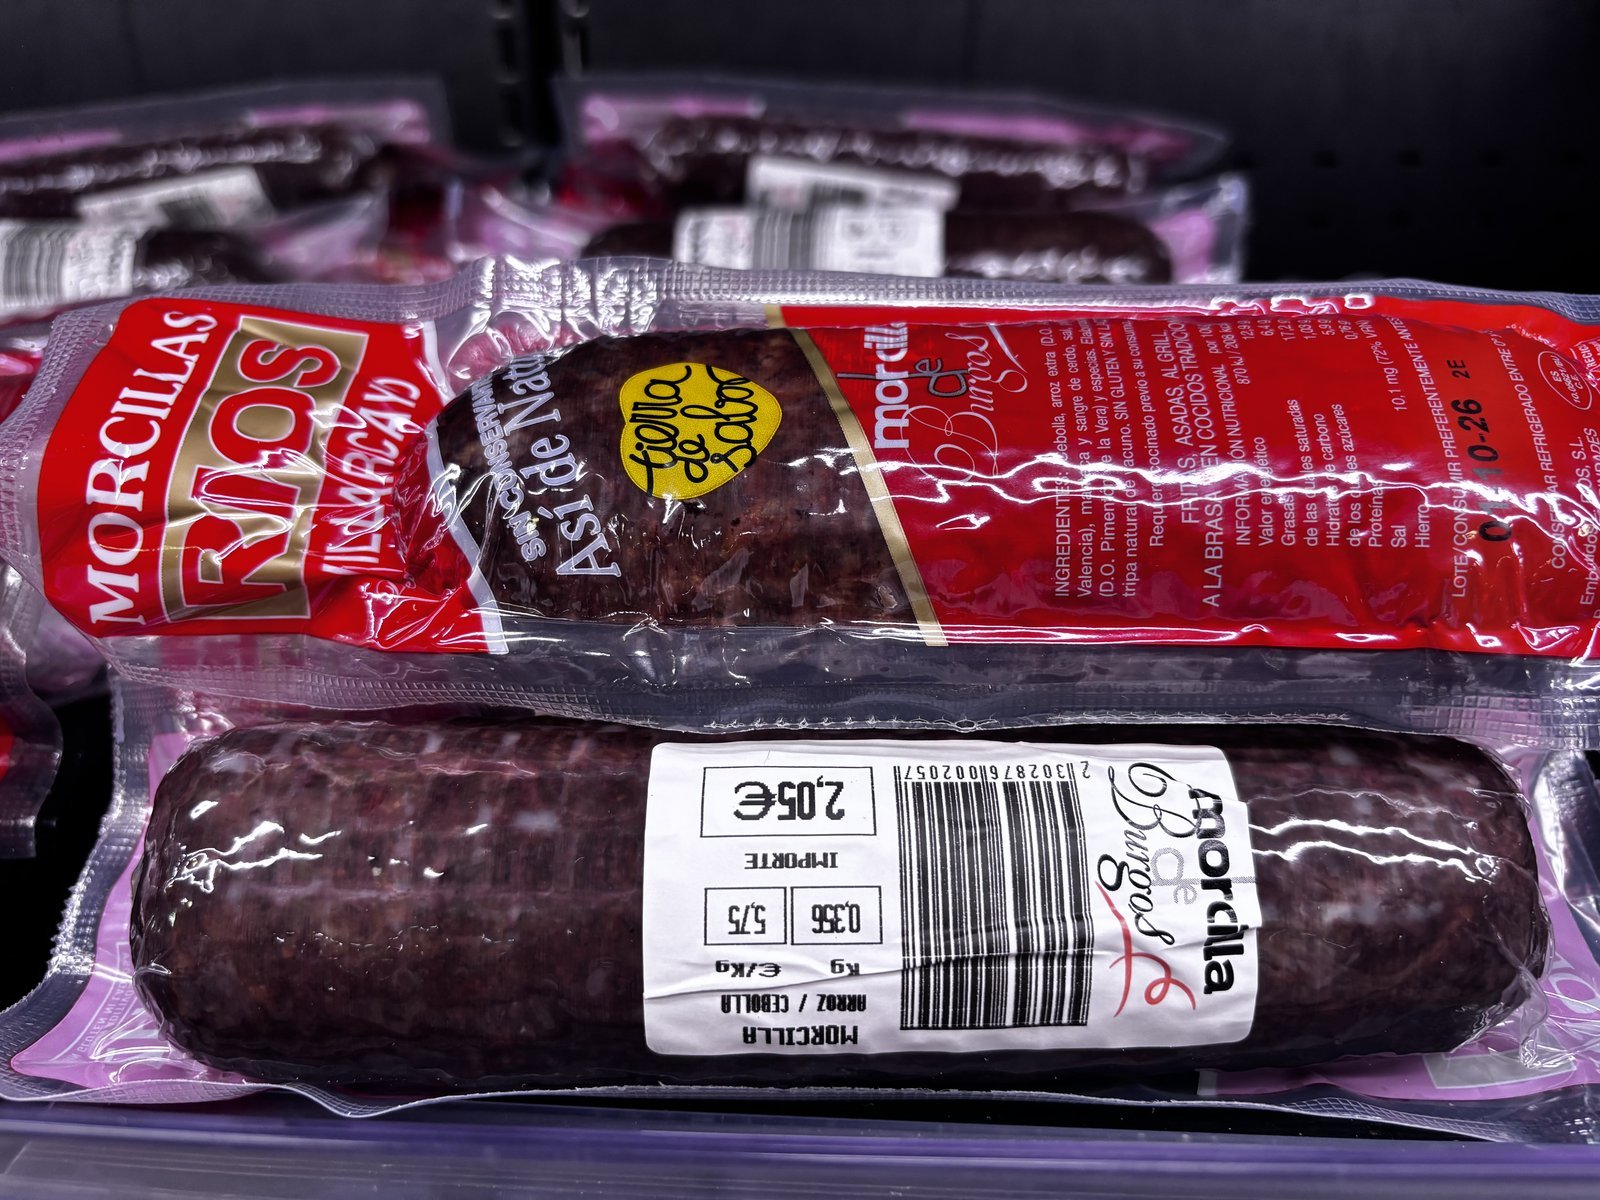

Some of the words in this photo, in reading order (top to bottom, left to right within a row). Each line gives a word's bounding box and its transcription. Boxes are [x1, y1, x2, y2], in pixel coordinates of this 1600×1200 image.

[1097, 333, 1114, 348] SIN
[1151, 331, 1175, 362] GRILL
[1205, 340, 1222, 354] por
[1370, 341, 1394, 365] (72%
[1044, 351, 1059, 377] extra
[1063, 344, 1079, 373] cerdo,
[1085, 348, 1104, 392] especias.
[1132, 358, 1144, 370] su
[1162, 365, 1180, 379] AL
[1229, 356, 1245, 366] kJ
[1447, 360, 1470, 379] 2E
[1497, 347, 1524, 381] ENTRE
[1067, 377, 1081, 391] de
[1103, 357, 1125, 398] GLUTEN
[1233, 368, 1251, 385] 870
[1383, 367, 1399, 385] mg
[1550, 370, 1562, 382] ES
[900, 332, 1028, 482] Burgos
[1049, 381, 1063, 408] arroz
[1112, 401, 1129, 420] SIN
[1135, 379, 1156, 412] previo
[1184, 373, 1215, 440] COCIDOS
[1211, 364, 1242, 436] NUTRICIONAL
[1388, 389, 1407, 411] 10,1
[1404, 343, 1459, 458] PREFERENTEMENTE
[629, 364, 692, 497] tierra
[681, 363, 759, 473] sabor
[1073, 395, 1089, 432] sangre
[1092, 405, 1110, 433] Vera)
[1165, 383, 1194, 446] ASADAS,
[1286, 399, 1310, 452] saturadas
[1331, 404, 1354, 452] azúcares
[1514, 384, 1554, 471] REFRIGERADO
[1077, 437, 1093, 445] y
[1097, 437, 1111, 449] la
[1142, 415, 1160, 469] cocinado
[1313, 413, 1334, 460] carbono
[1569, 436, 1587, 461] S.L.
[86, 311, 217, 625] MORCILLAS
[179, 338, 342, 608] RIOS
[519, 433, 582, 487] de
[677, 433, 711, 484] de
[1198, 445, 1220, 468] EN
[1123, 480, 1137, 498] de
[1227, 439, 1251, 545] INFORMAIÓN
[1575, 465, 1593, 503] ROS,
[1123, 501, 1138, 557] natural
[1203, 490, 1224, 559] BRASA
[1258, 509, 1274, 546] Valor
[1280, 495, 1296, 546] Grasas
[1303, 503, 1318, 523] las
[1347, 503, 1361, 523] los
[1368, 480, 1383, 547] Proteínas
[1414, 504, 1430, 548] Hierro
[1543, 475, 1566, 569] CONSERAR
[507, 510, 548, 562] SIN
[538, 494, 622, 578] Así
[1055, 472, 1071, 597] INGREDIENTES:
[1303, 528, 1318, 546] de
[1346, 529, 1360, 547] de
[1390, 525, 1406, 547] Sal
[1077, 523, 1097, 598] Valencia),
[1203, 565, 1223, 589] LA
[1099, 559, 1117, 597] (D.O.
[1122, 562, 1140, 598] tripa
[1202, 594, 1220, 607] A
[904, 764, 978, 781] 002057
[988, 763, 1066, 781] 302876
[733, 776, 846, 821] 2,05€
[744, 851, 839, 870] IMPORTE
[1097, 761, 1200, 945] Burgos
[1188, 788, 1245, 995] morcilla
[727, 901, 767, 935] 5,75
[811, 900, 862, 934] 0,356
[715, 959, 782, 979] €/Kg
[830, 958, 861, 976] Kg
[720, 993, 790, 1014] CEBOLLA
[816, 993, 868, 1013] ARROZ
[742, 1025, 859, 1046] MORCILLA
